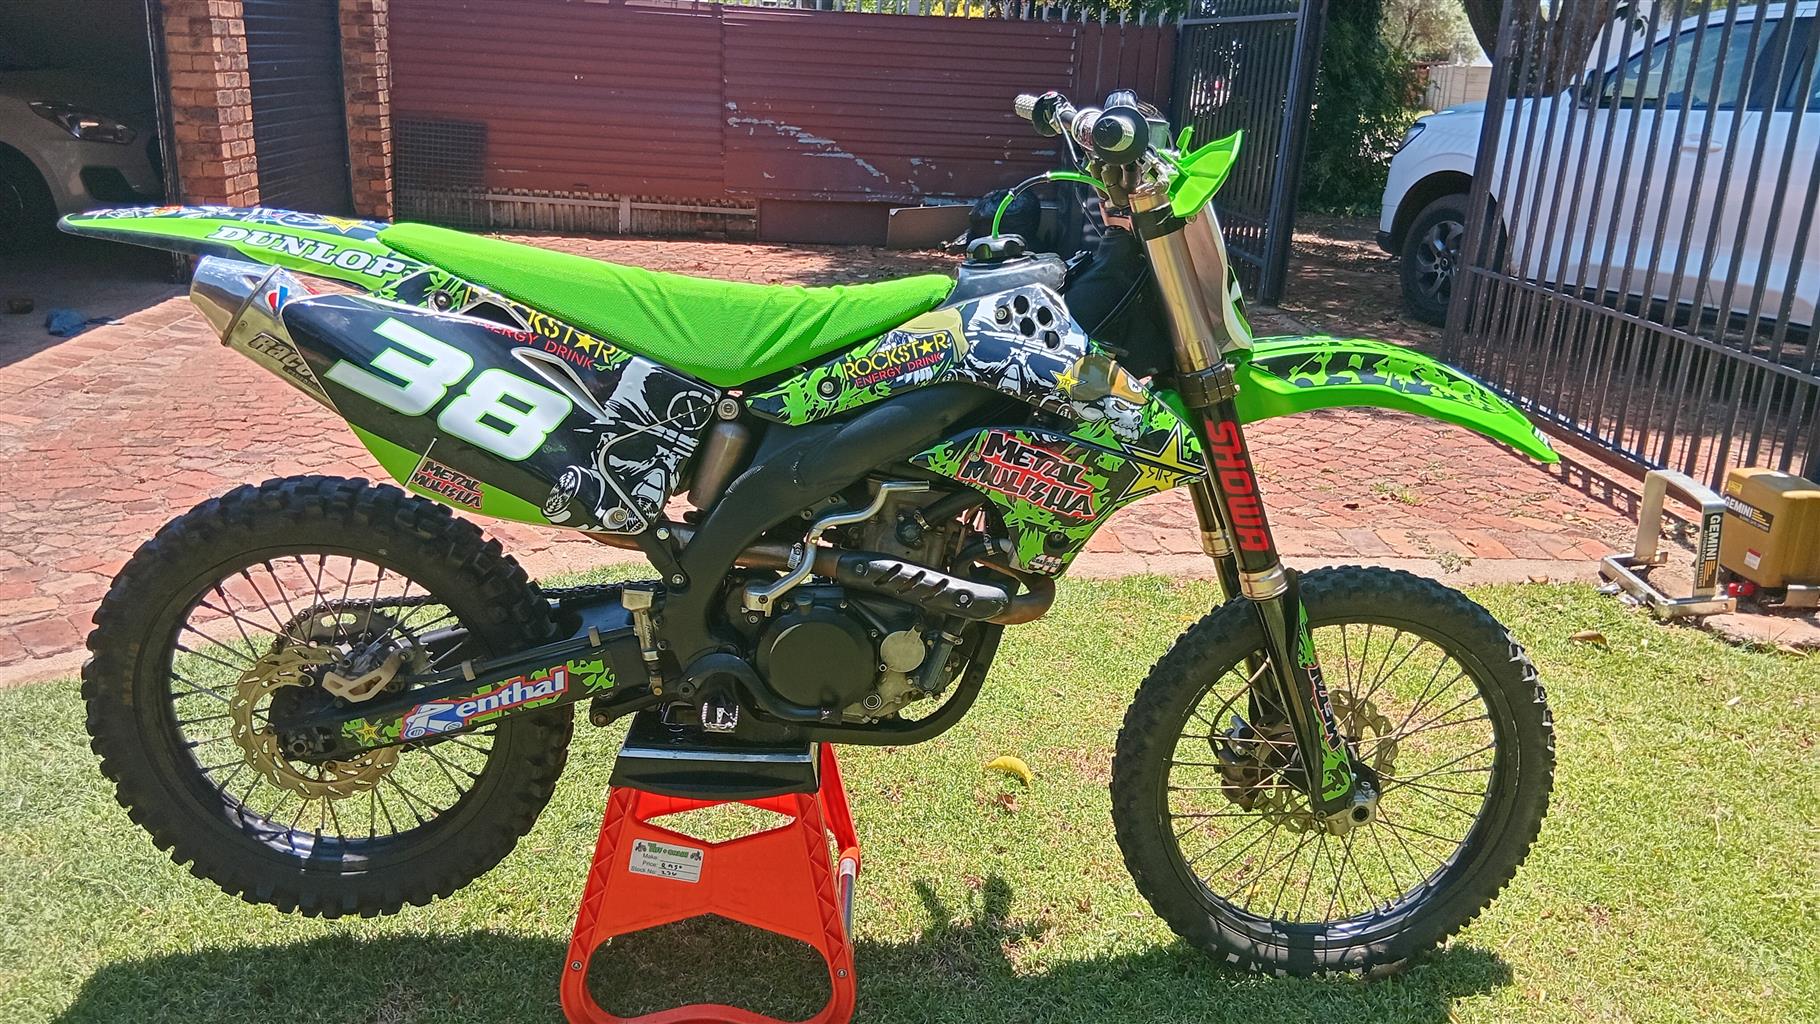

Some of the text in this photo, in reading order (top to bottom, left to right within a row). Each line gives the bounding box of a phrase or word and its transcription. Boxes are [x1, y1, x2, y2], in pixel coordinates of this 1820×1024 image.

[211, 226, 406, 277] DUNLOP
[544, 340, 595, 370] DRINK
[855, 352, 942, 388] ENERGY DRINK
[323, 317, 573, 462] 38
[421, 460, 482, 493] METAL
[981, 431, 1091, 489] METAL
[1205, 420, 1269, 551] SHOWA
[959, 458, 1094, 517] MULISHA
[1724, 496, 1753, 518] GEMINI
[1706, 514, 1720, 561] GEMINI
[405, 671, 565, 738] Renthal
